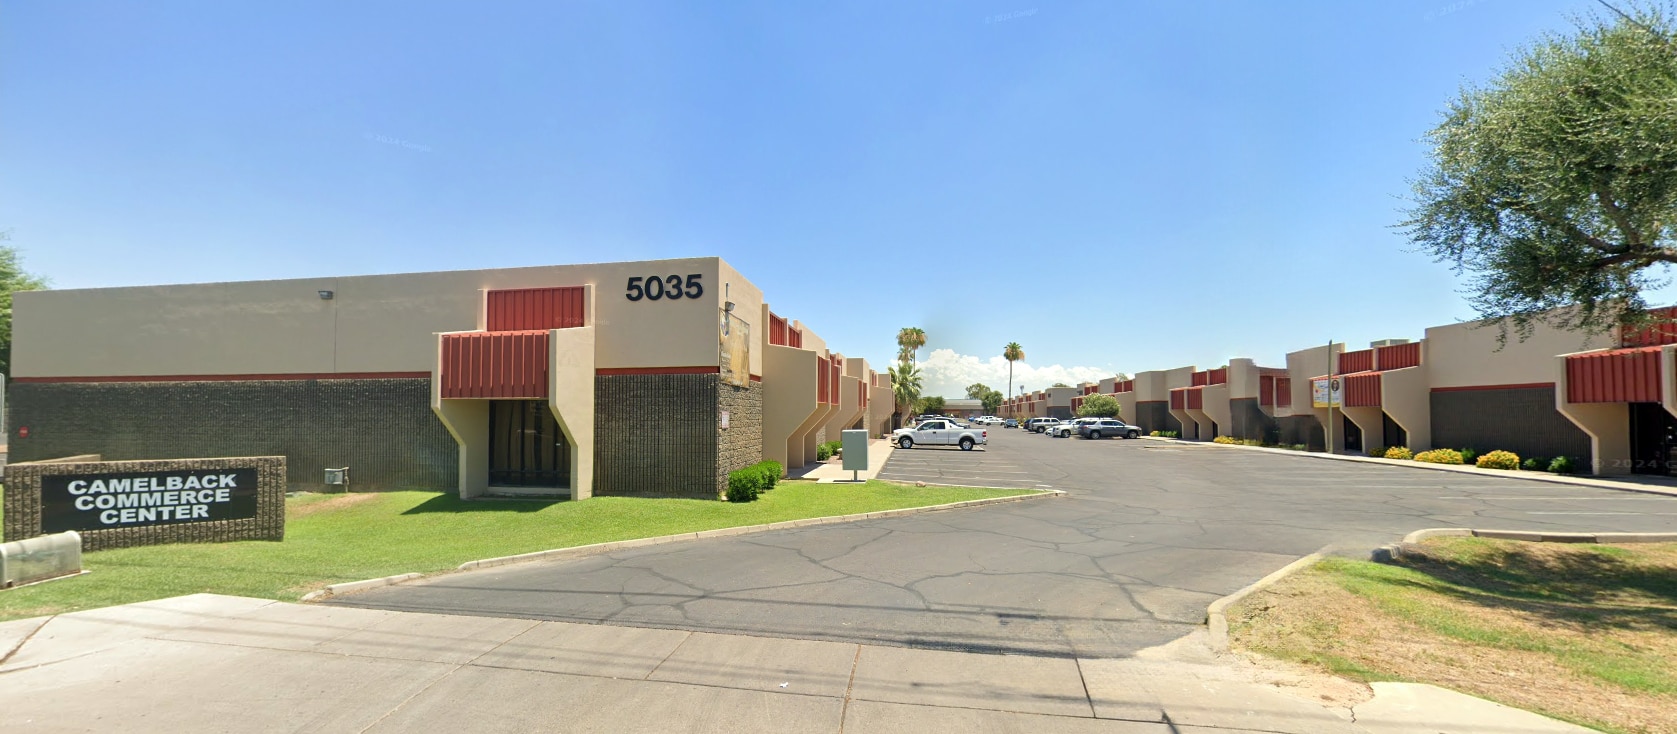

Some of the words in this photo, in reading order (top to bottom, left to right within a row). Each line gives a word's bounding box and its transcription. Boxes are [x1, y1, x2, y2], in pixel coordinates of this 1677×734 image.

[626, 273, 703, 301] 5035
[67, 473, 237, 496] CAMELBACK
[75, 488, 231, 511] COMMERCE
[99, 504, 209, 525] CENTER
